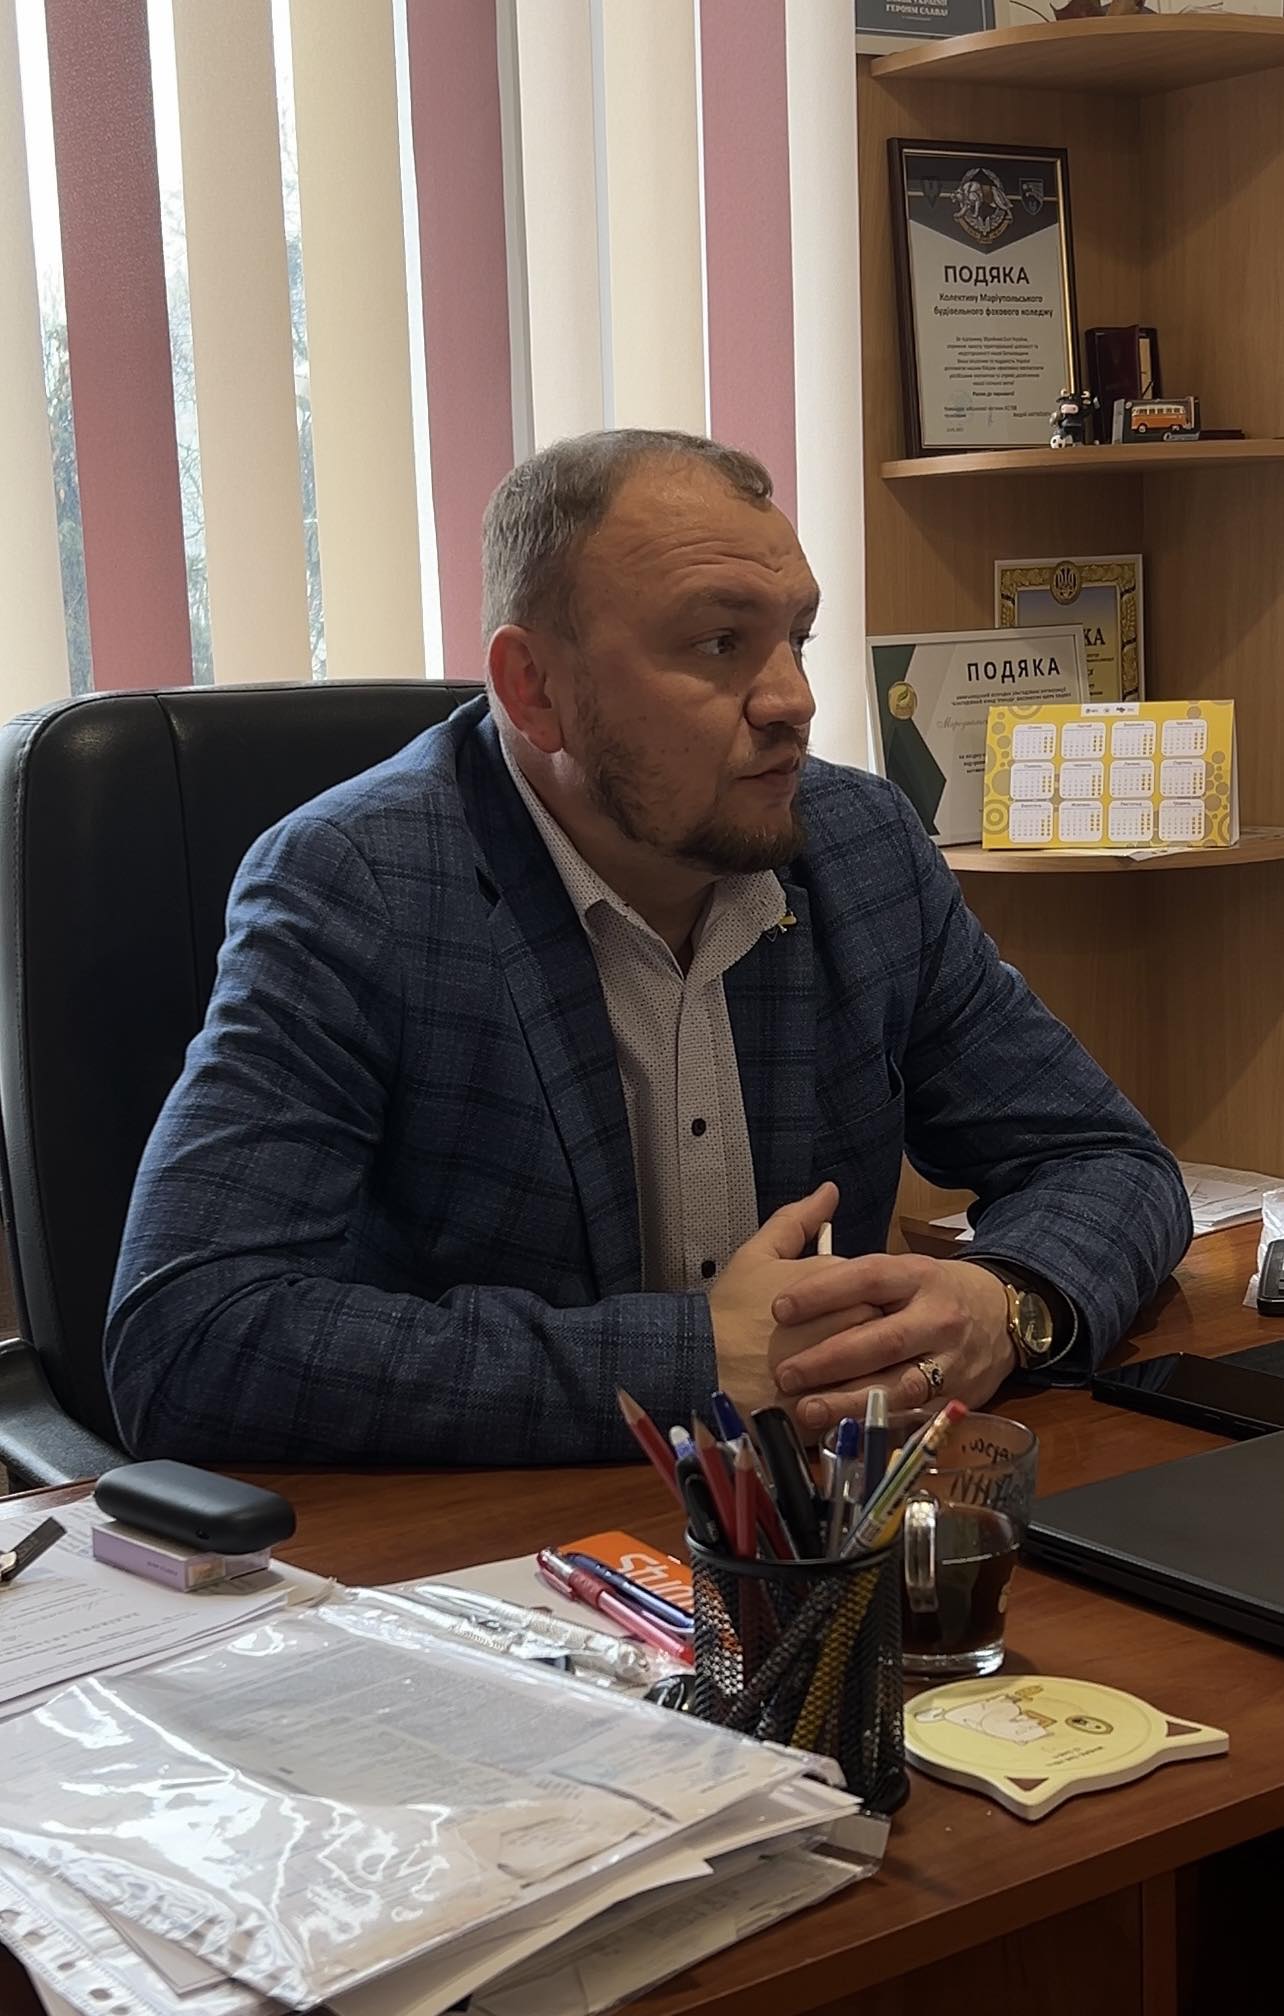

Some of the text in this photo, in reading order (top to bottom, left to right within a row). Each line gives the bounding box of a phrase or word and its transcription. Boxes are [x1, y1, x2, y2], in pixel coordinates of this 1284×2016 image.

[944, 265, 1030, 287] ПОДЯКА
[940, 293, 978, 303] Колективу
[967, 657, 1061, 684] ПОДЯКА
